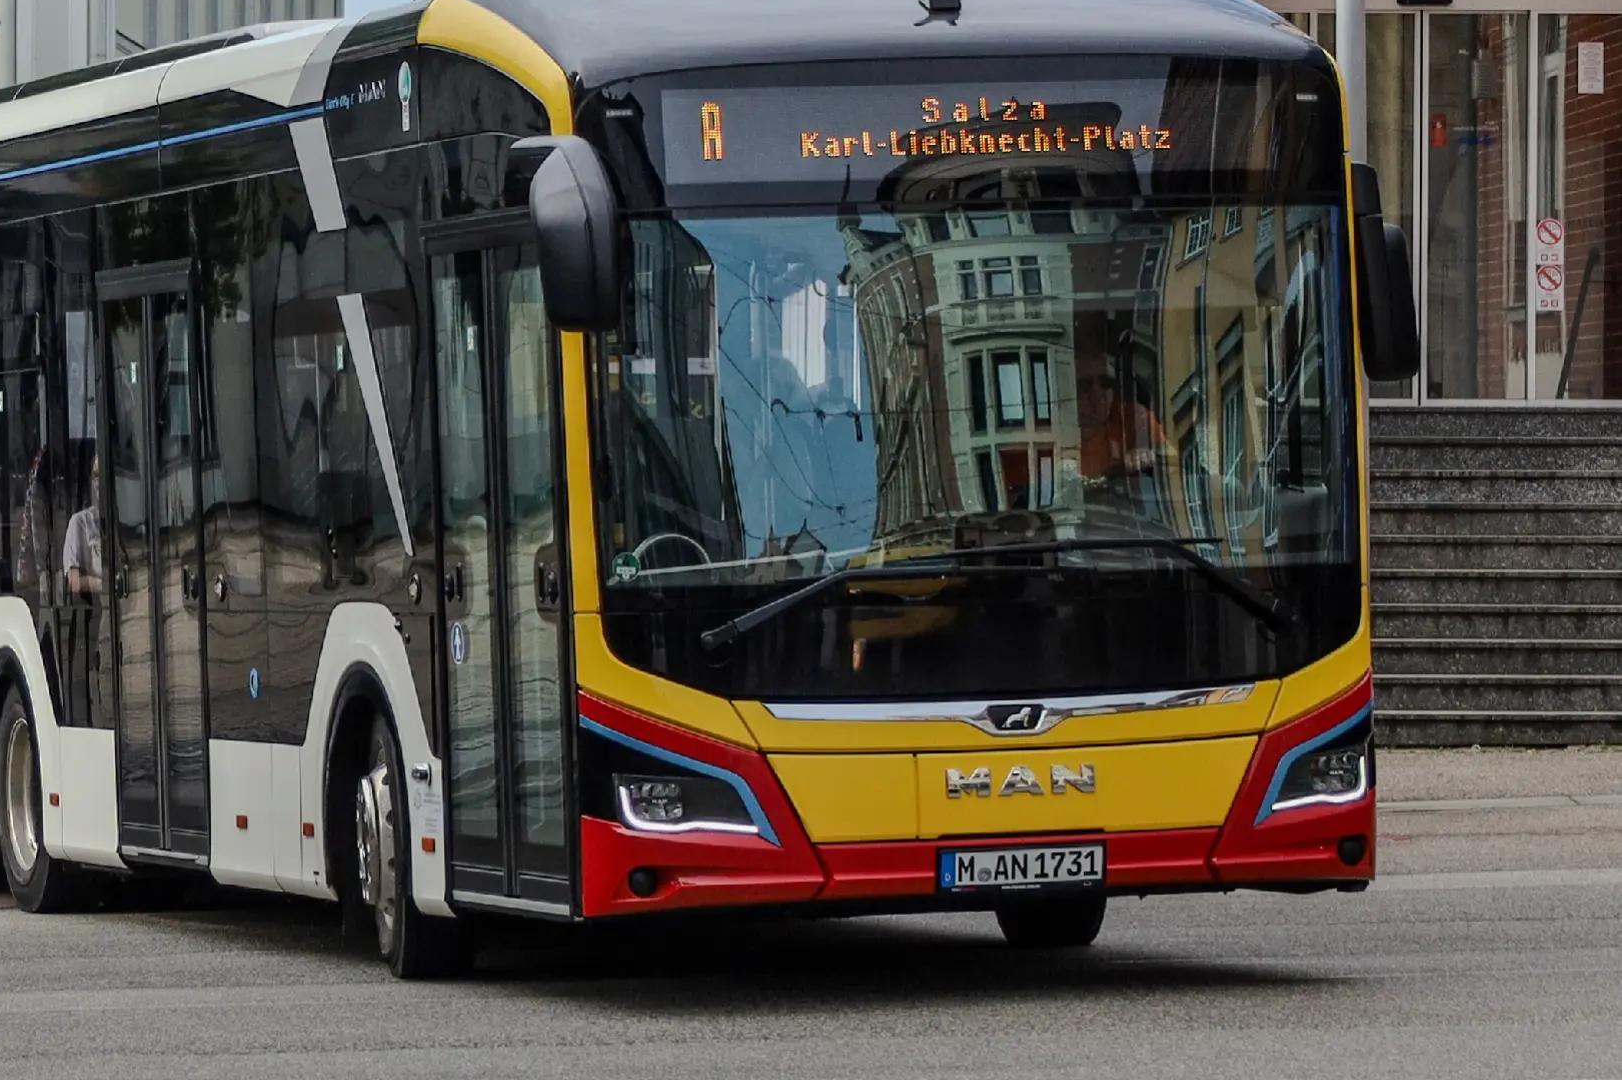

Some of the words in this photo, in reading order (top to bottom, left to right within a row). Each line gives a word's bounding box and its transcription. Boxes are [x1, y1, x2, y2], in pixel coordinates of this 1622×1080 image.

[359, 80, 386, 103] MAN
[921, 96, 1047, 122] Salza
[701, 97, 722, 160] A
[801, 124, 1171, 157] Karl-Liebknecht-Platz
[946, 764, 1095, 798] MAN
[958, 855, 975, 882] M
[994, 853, 1028, 880] AN
[1034, 850, 1099, 879] 1731
